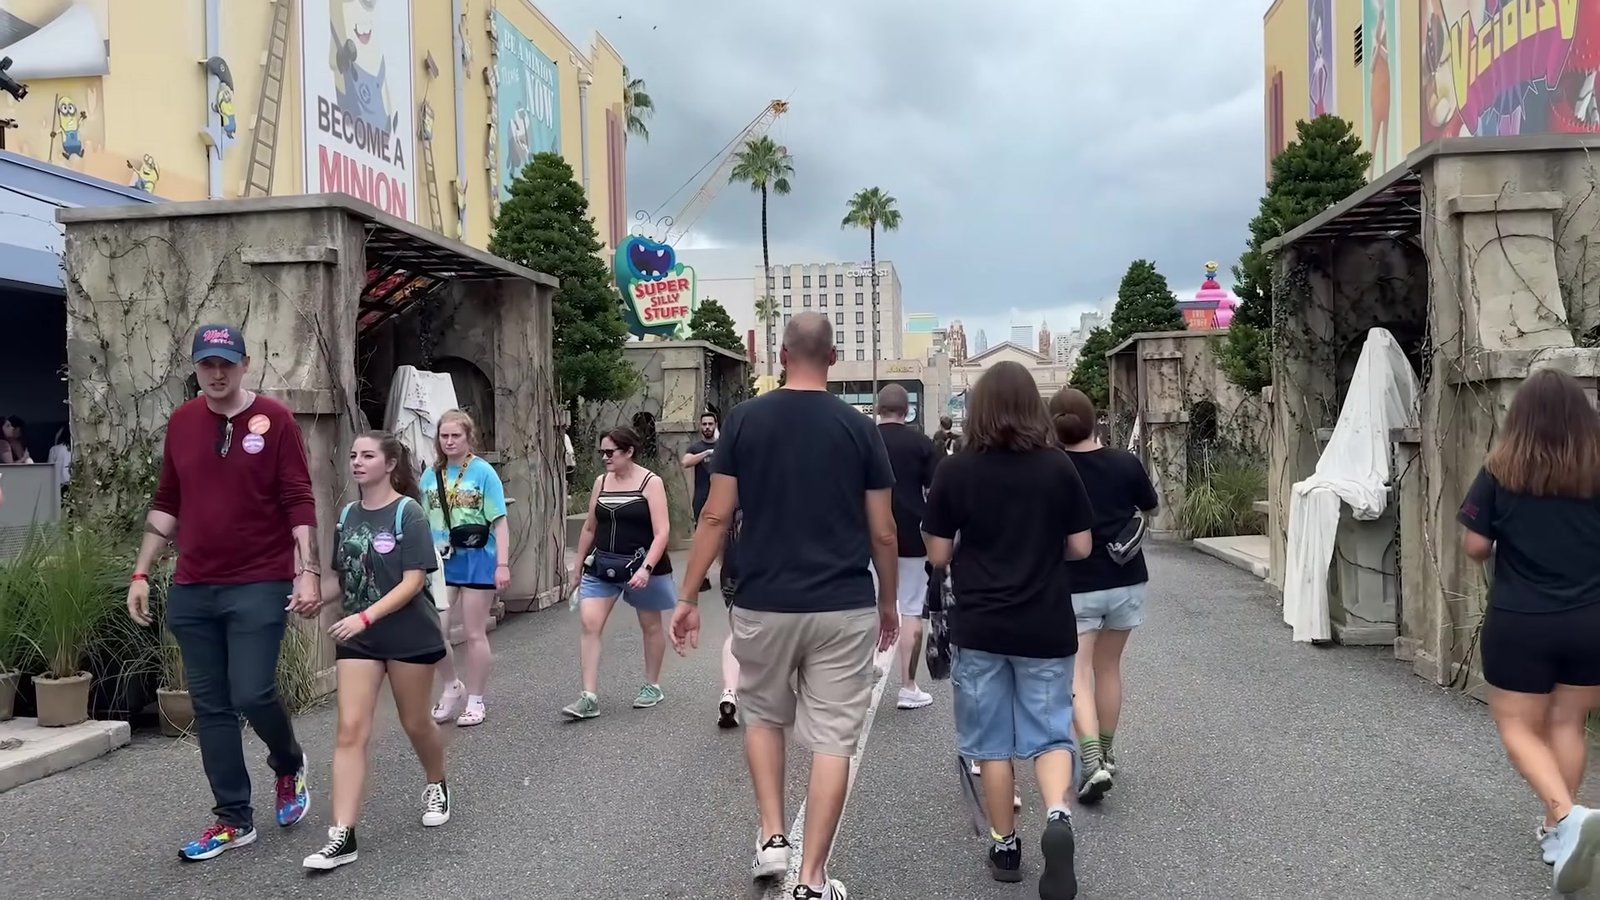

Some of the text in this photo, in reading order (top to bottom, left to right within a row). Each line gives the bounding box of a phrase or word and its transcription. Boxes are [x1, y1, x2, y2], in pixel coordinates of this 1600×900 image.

[504, 30, 554, 88] BE A MINION
[525, 68, 554, 130] NOW
[318, 95, 405, 171] BECOME A
[319, 144, 407, 221] MINION
[635, 278, 690, 299] SUPER
[644, 306, 688, 321] STUFF
[650, 293, 680, 308] SILLY
